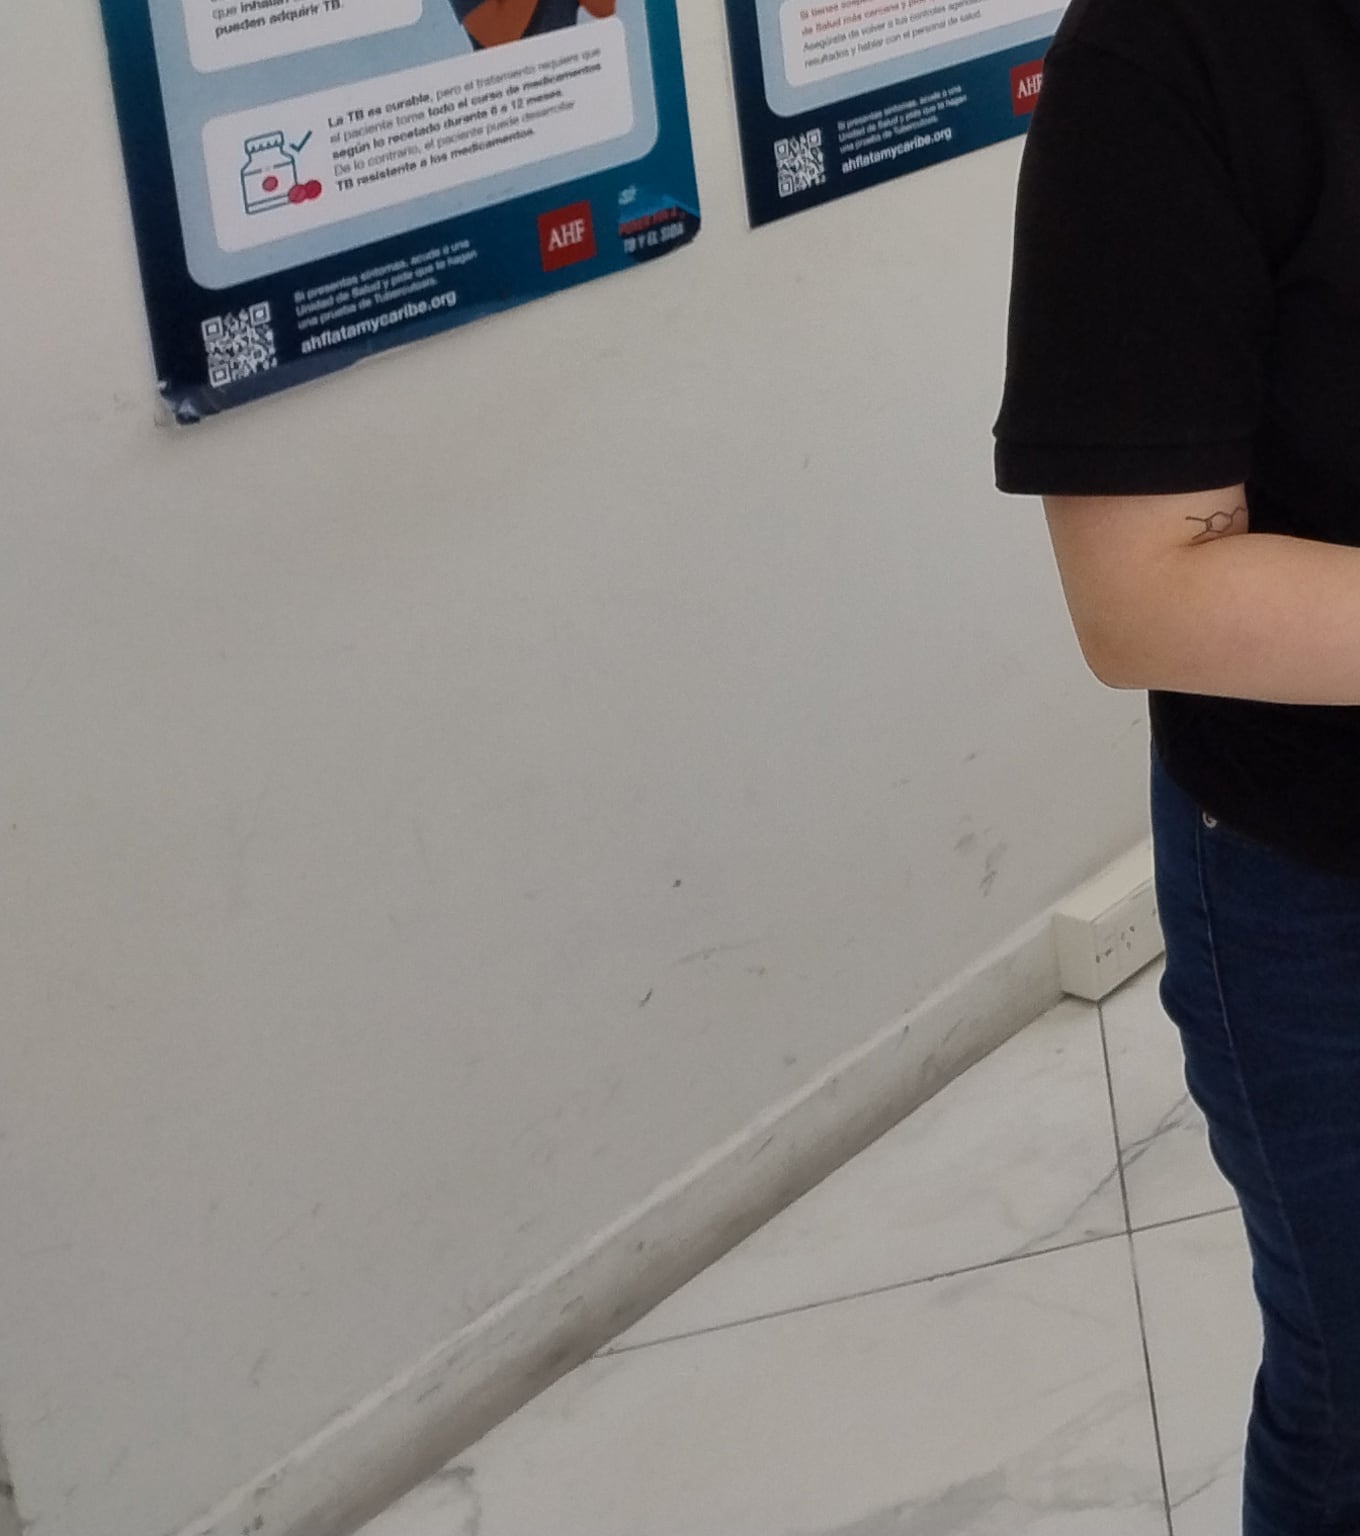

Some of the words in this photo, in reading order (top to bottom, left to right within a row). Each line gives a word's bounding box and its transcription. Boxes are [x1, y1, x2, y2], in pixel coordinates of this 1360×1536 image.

[212, 5, 237, 20] que
[215, 16, 265, 37] pueden
[269, 4, 319, 24] adquirir
[548, 218, 586, 252] AHF
